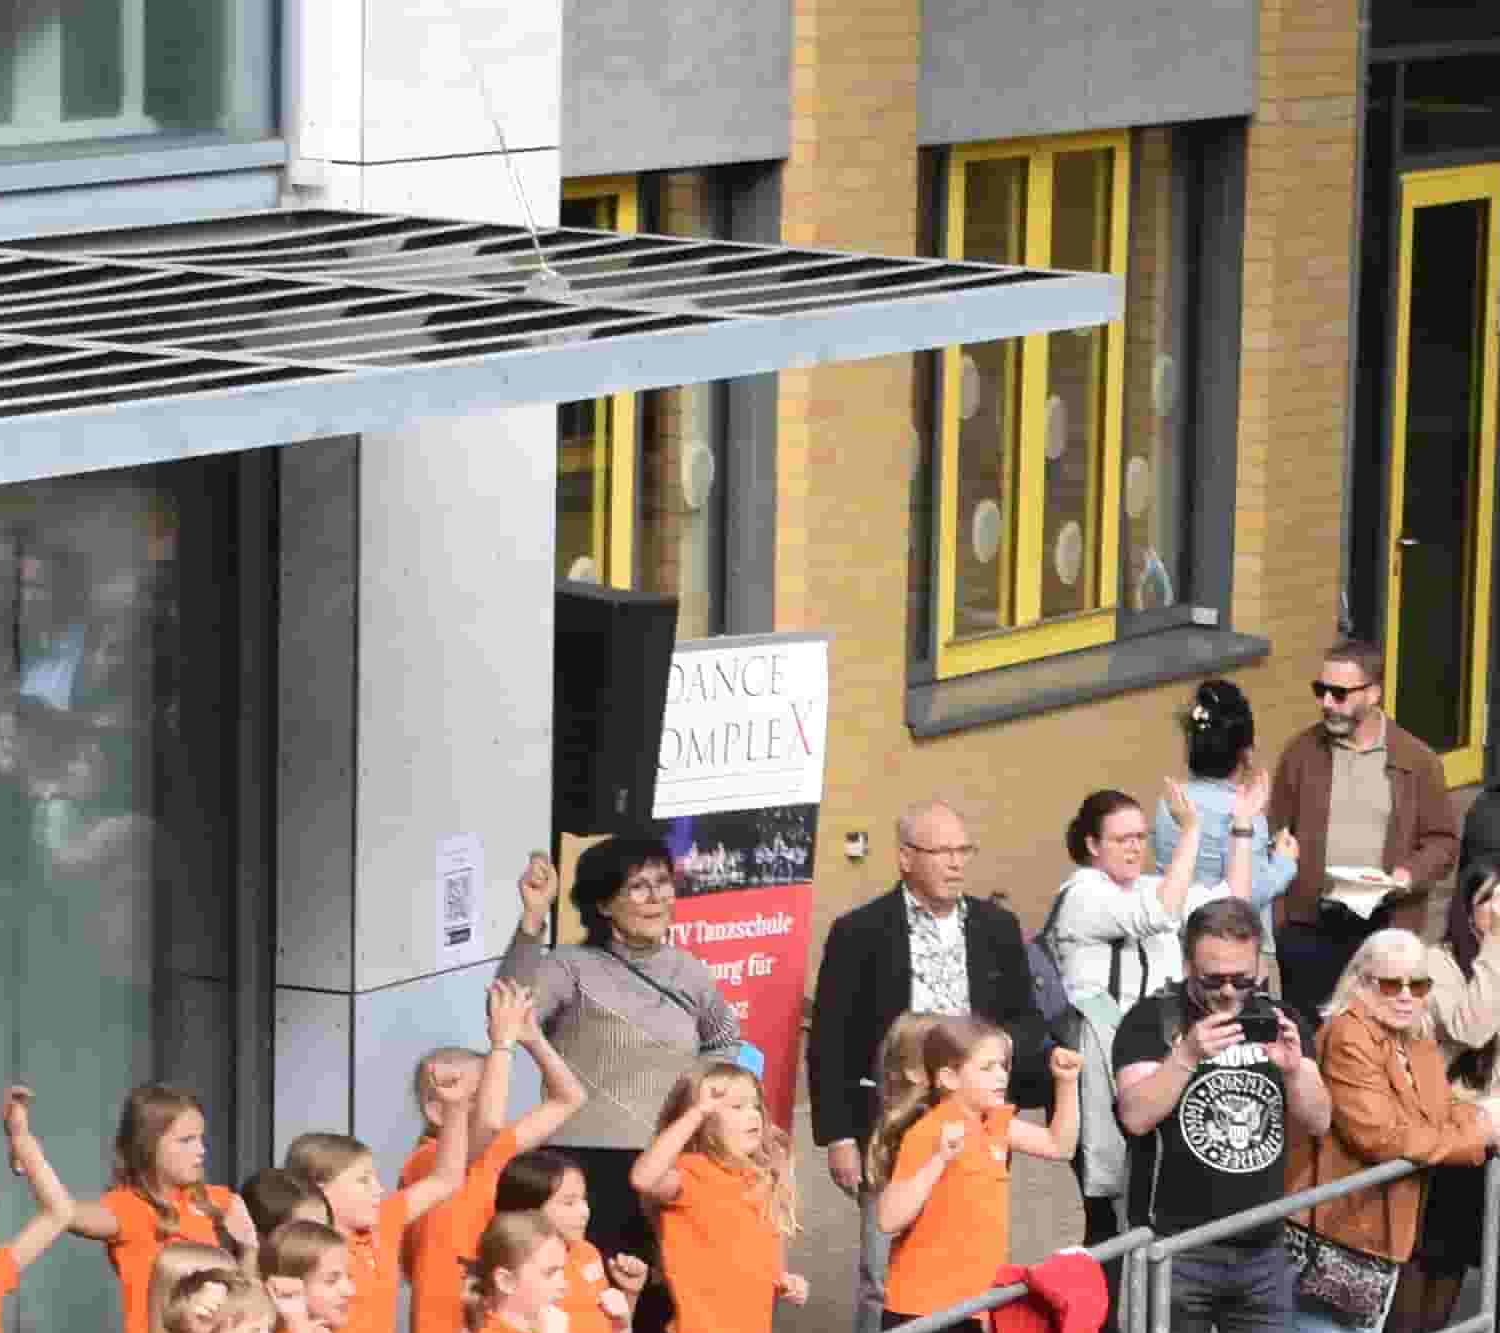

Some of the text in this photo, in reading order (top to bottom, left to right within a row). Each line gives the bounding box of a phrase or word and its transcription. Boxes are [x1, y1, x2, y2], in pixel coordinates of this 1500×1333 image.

[669, 655, 788, 703] DANCE
[657, 700, 813, 770] OMPLEX
[695, 911, 795, 945] Tanzschule
